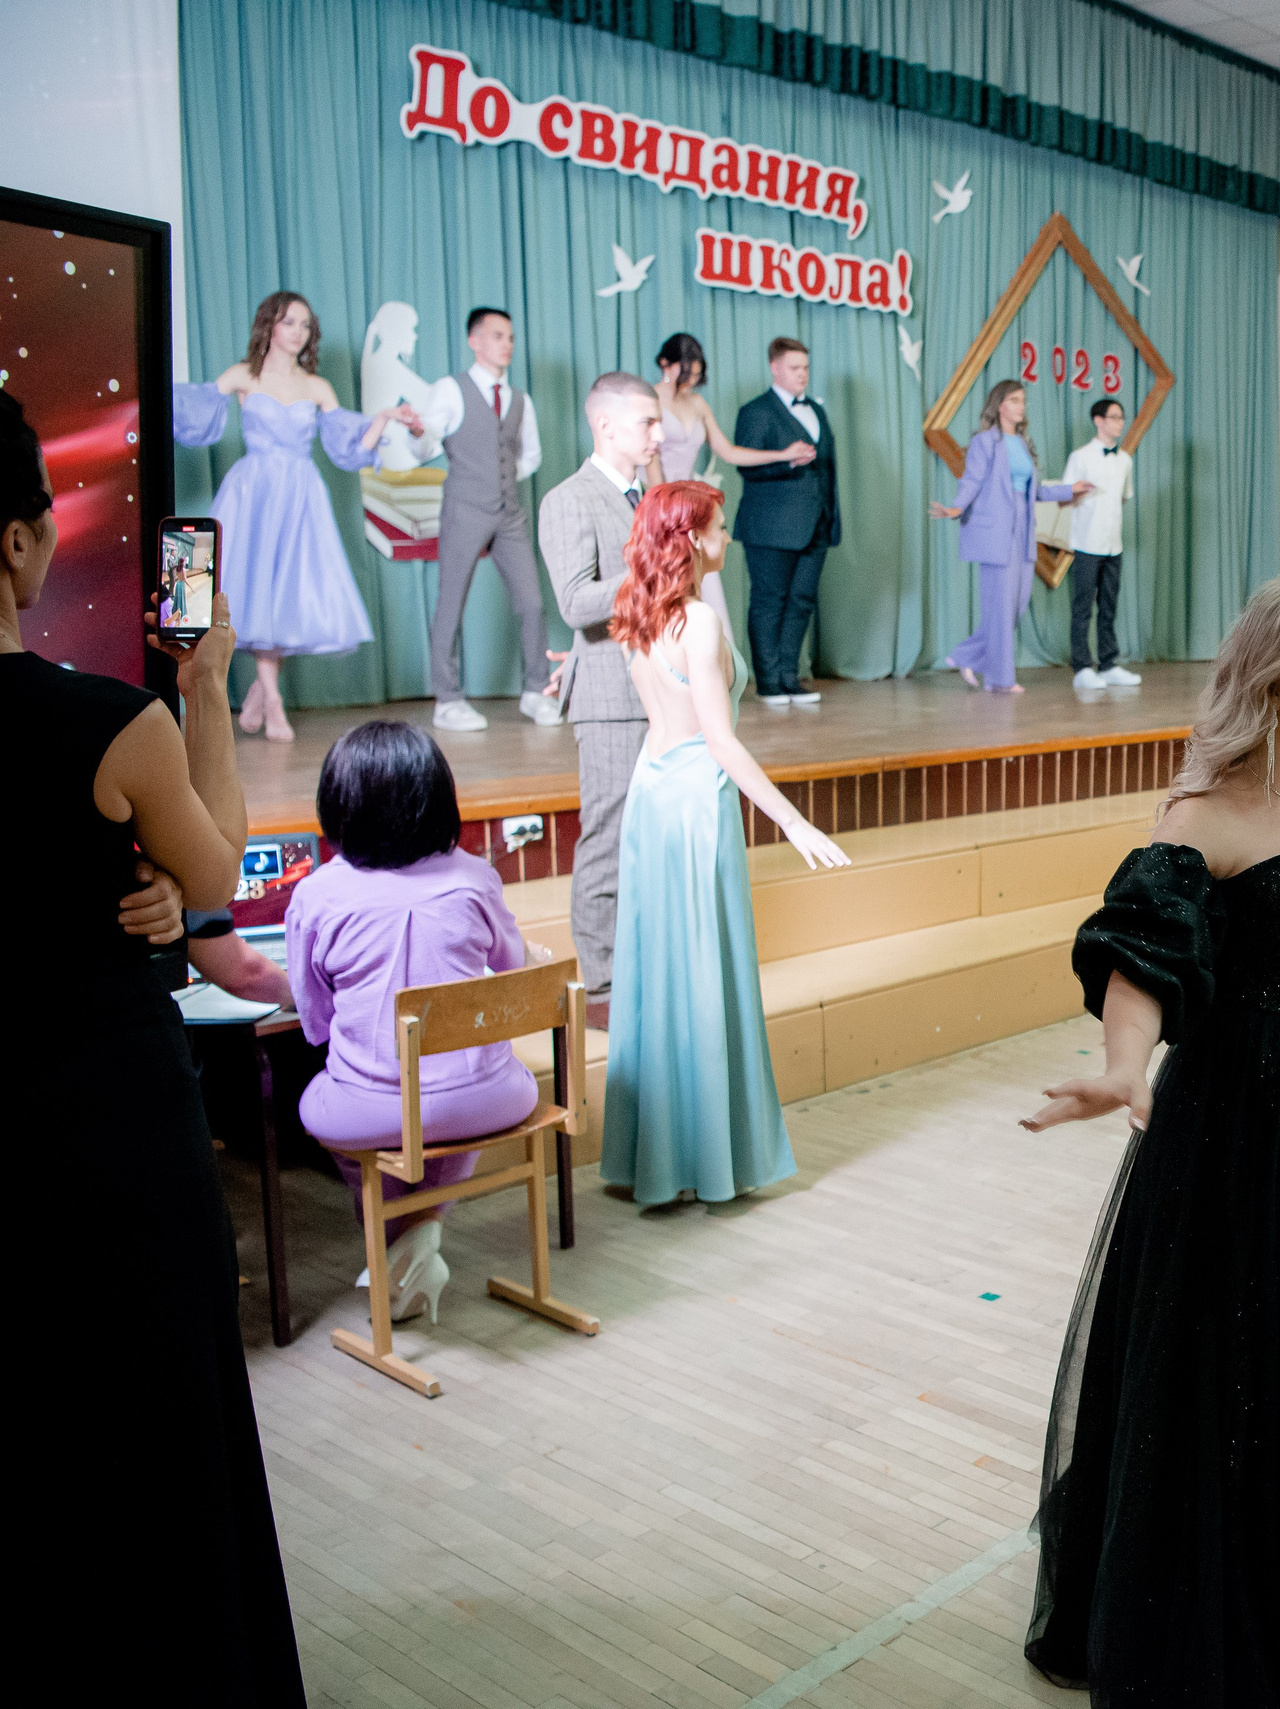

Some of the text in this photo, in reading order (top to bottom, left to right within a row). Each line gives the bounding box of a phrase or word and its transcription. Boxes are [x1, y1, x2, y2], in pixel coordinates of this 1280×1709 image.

[405, 48, 868, 236] До свидания,
[699, 232, 907, 312] школа!
[1020, 341, 1122, 395] 2023
